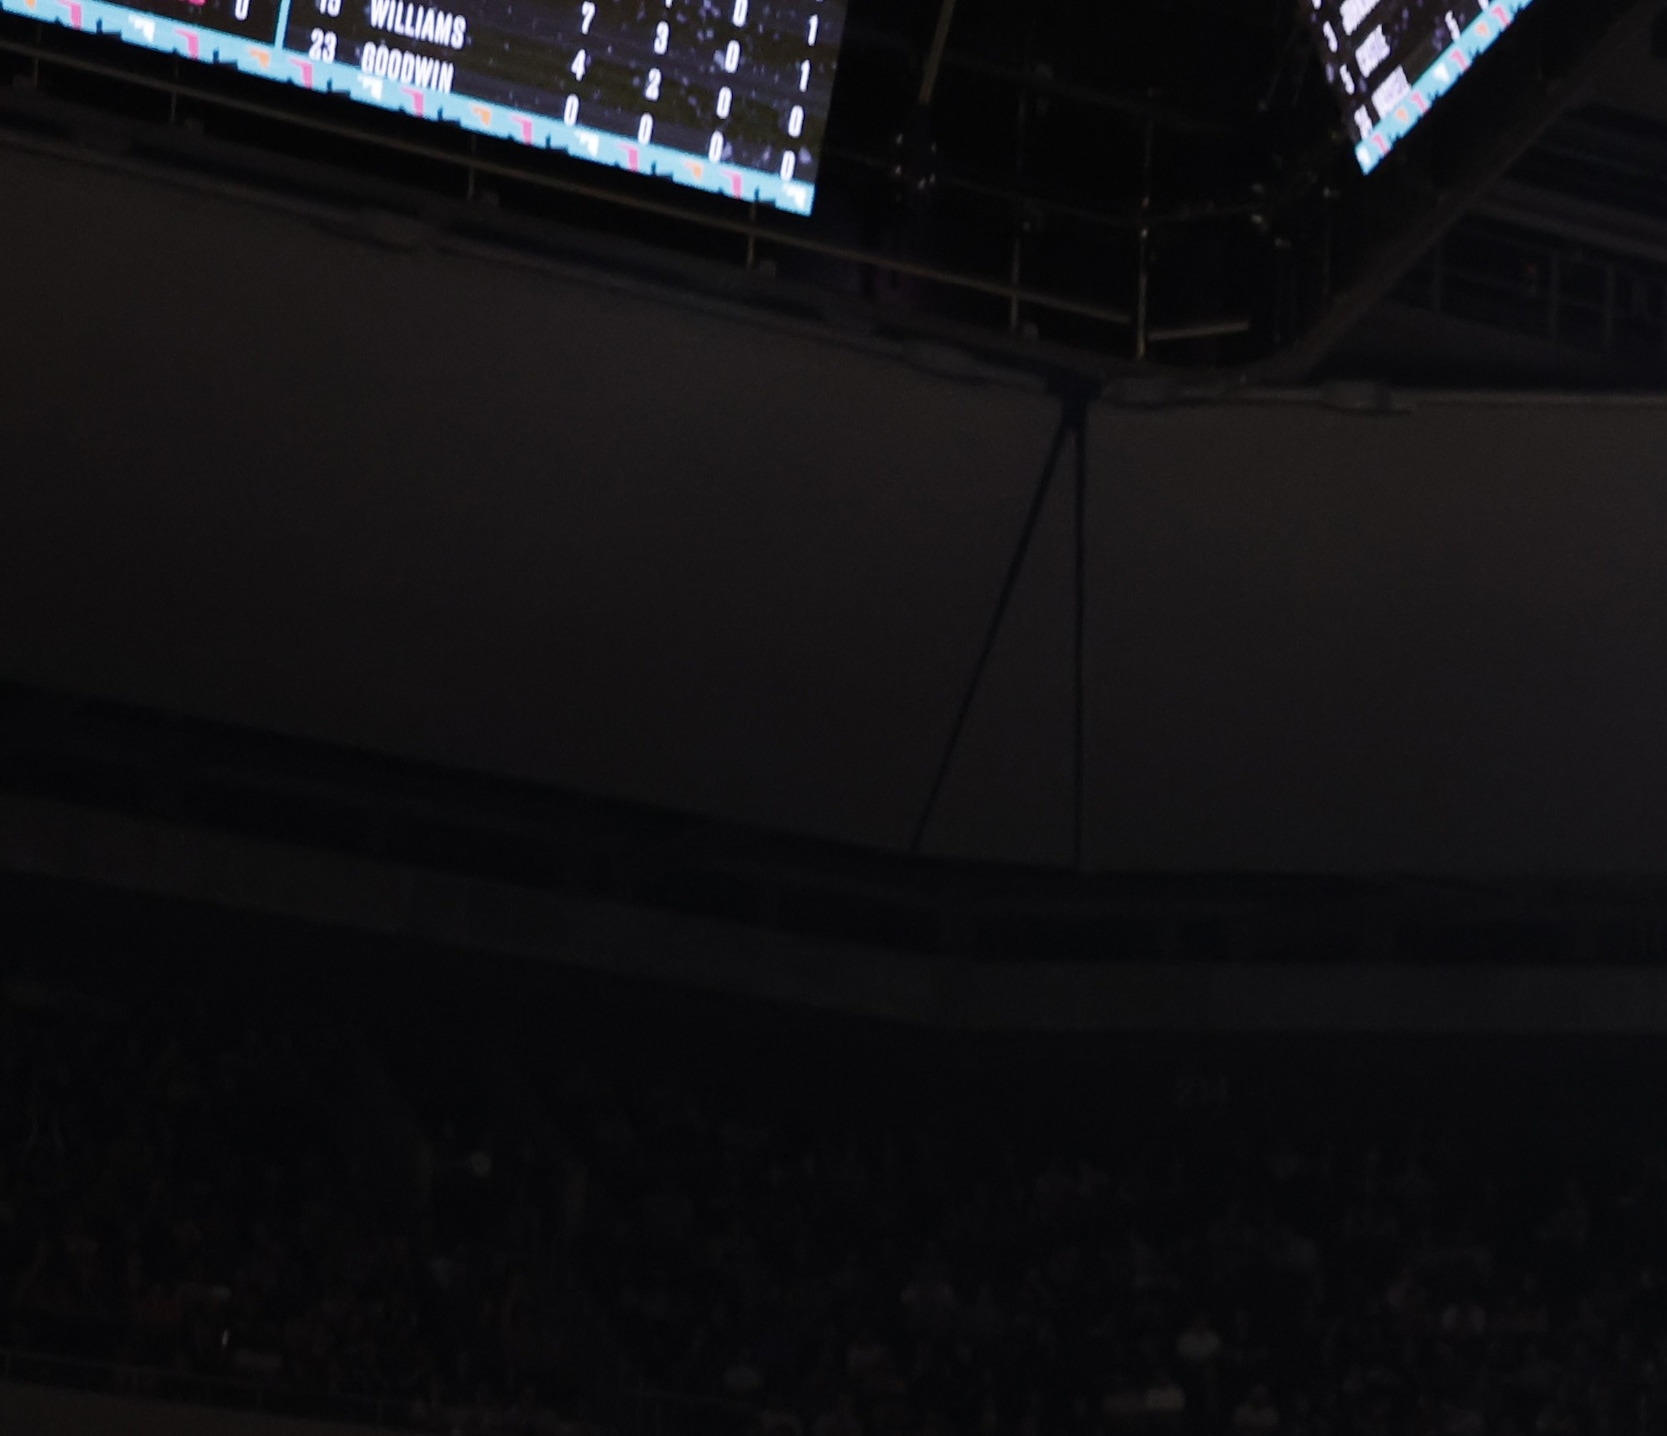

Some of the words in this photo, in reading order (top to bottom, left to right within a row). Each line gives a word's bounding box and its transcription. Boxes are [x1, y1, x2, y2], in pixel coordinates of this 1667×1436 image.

[370, 0, 467, 49] WILLIAMS
[571, 49, 586, 82] 4
[646, 68, 662, 101] 2
[717, 86, 732, 119] 0
[788, 105, 803, 138] 0
[582, 1, 596, 35] 7
[654, 21, 669, 54] 3
[725, 40, 740, 73] 0
[799, 59, 811, 92] 1
[807, 14, 819, 46] 1
[308, 28, 338, 64] 23
[360, 42, 454, 93] GOODWIN
[564, 94, 580, 126] 0
[638, 113, 653, 144] 0
[709, 131, 724, 162] 0
[780, 150, 795, 181] 0
